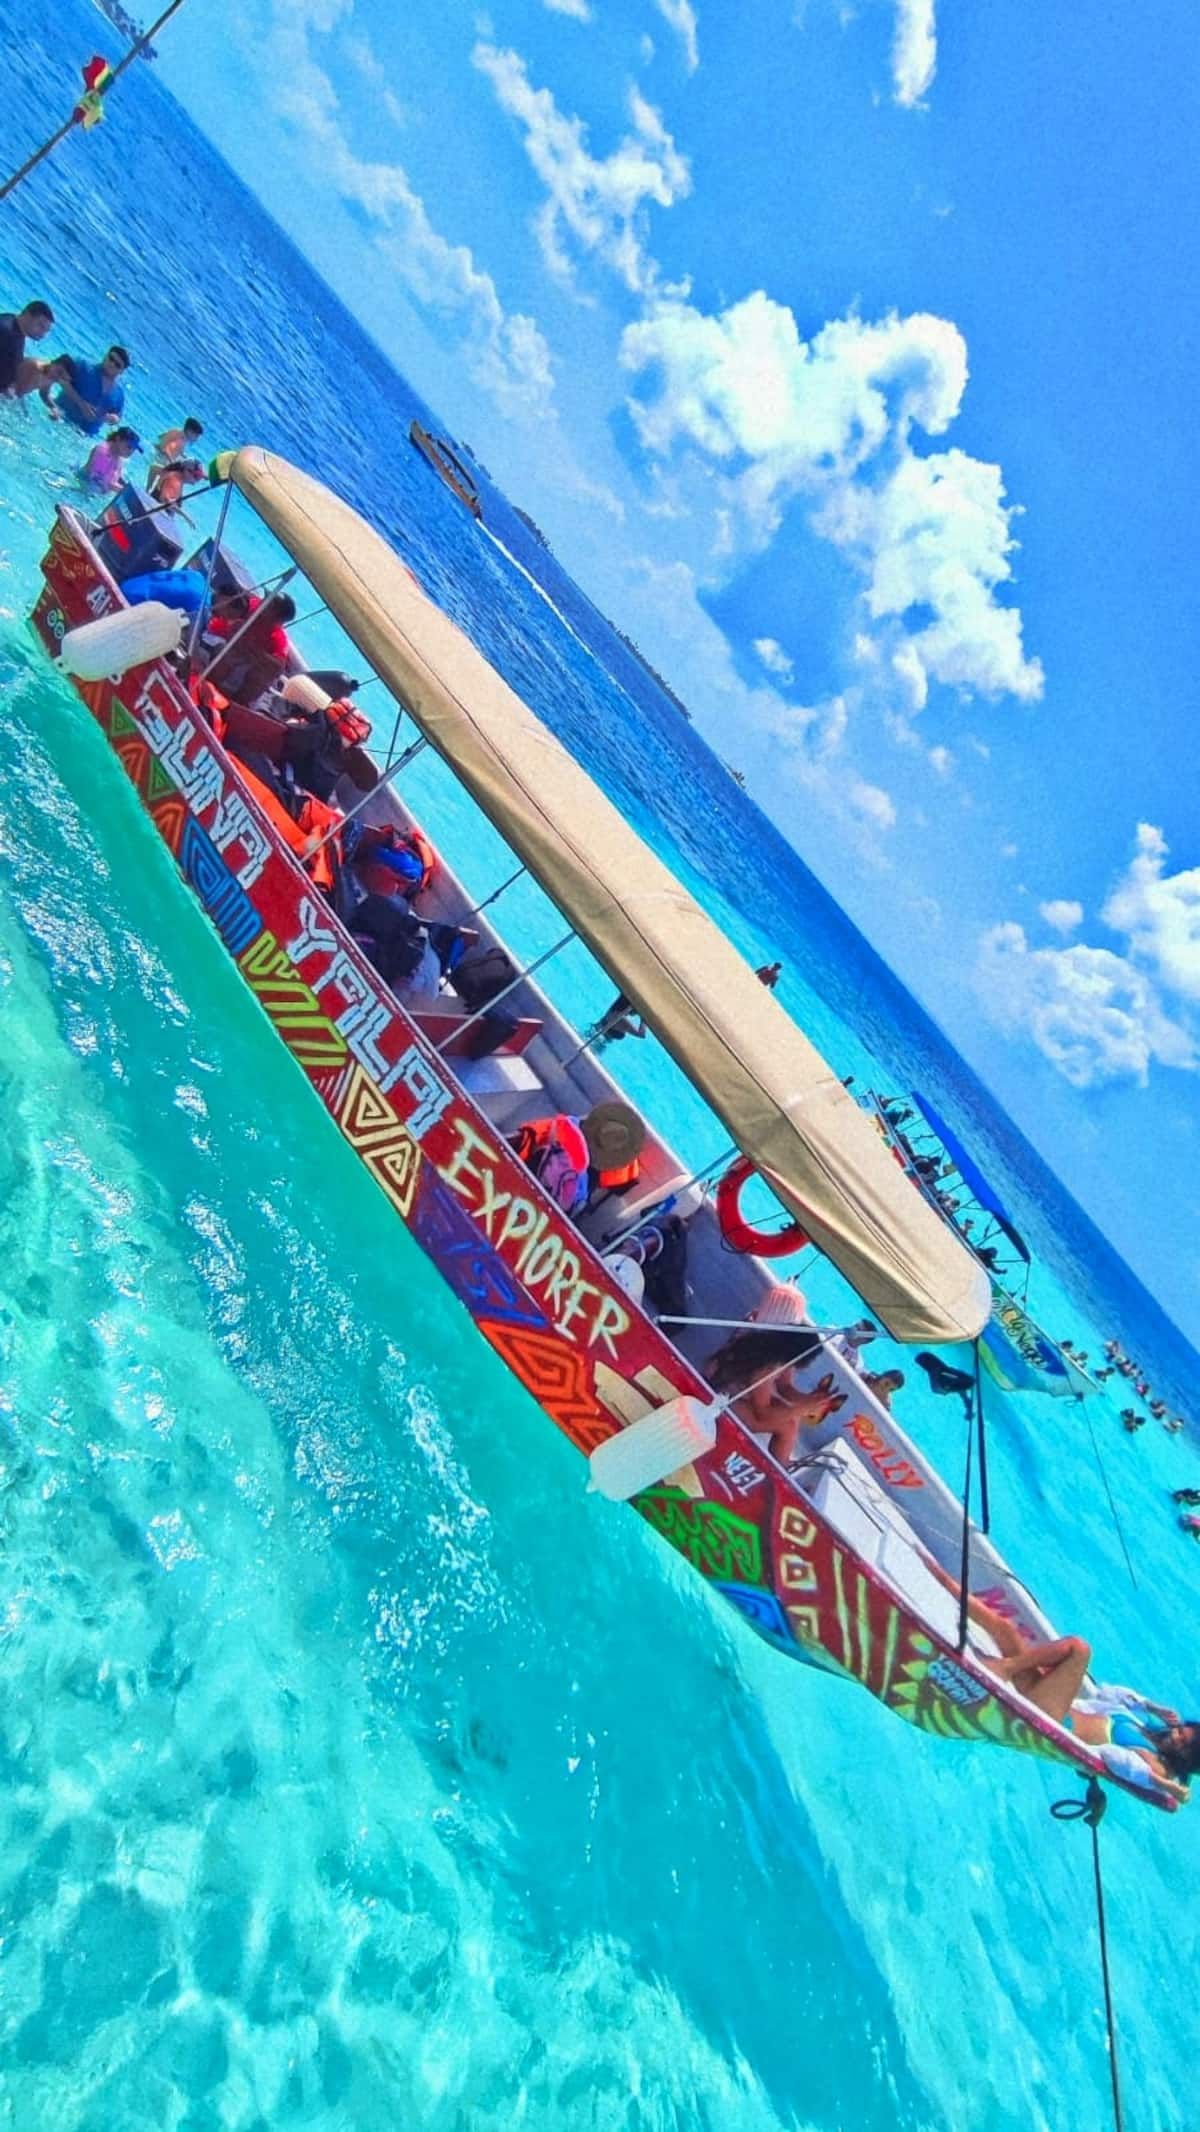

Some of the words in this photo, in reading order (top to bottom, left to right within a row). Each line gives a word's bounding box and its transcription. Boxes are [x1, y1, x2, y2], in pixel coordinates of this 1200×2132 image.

[286, 897, 453, 1141] YALA
[437, 1118, 631, 1360] EXPLORER
[843, 1414, 925, 1488] ROLLY
